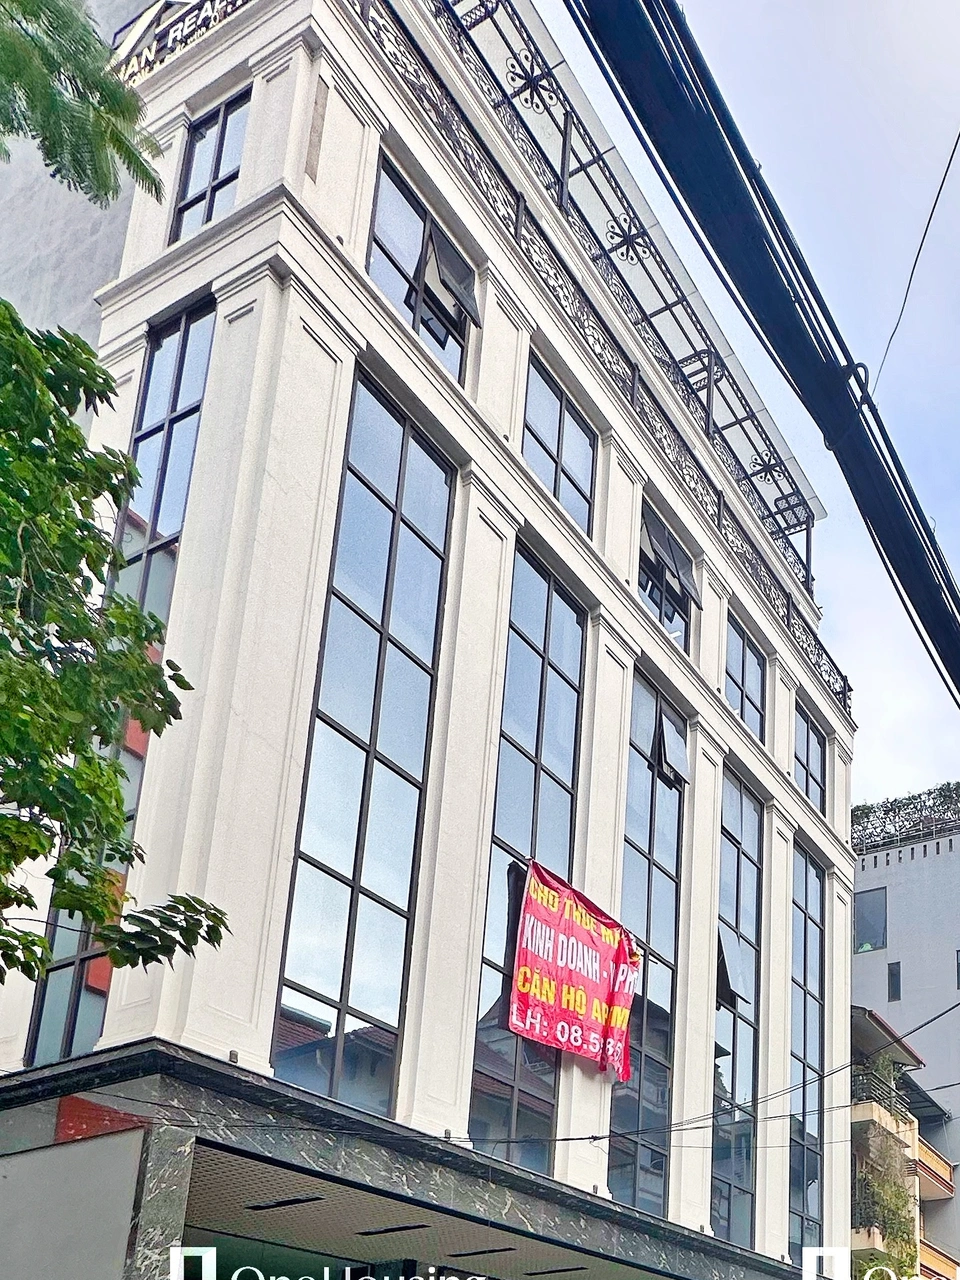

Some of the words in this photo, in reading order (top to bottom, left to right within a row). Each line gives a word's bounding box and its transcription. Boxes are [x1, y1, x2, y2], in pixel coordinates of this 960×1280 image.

[522, 912, 555, 963] KINH
[557, 932, 600, 984] DOANH
[511, 1003, 549, 1037] LH:
[517, 965, 556, 1005] CĂN
[561, 985, 587, 1021] HỘ
